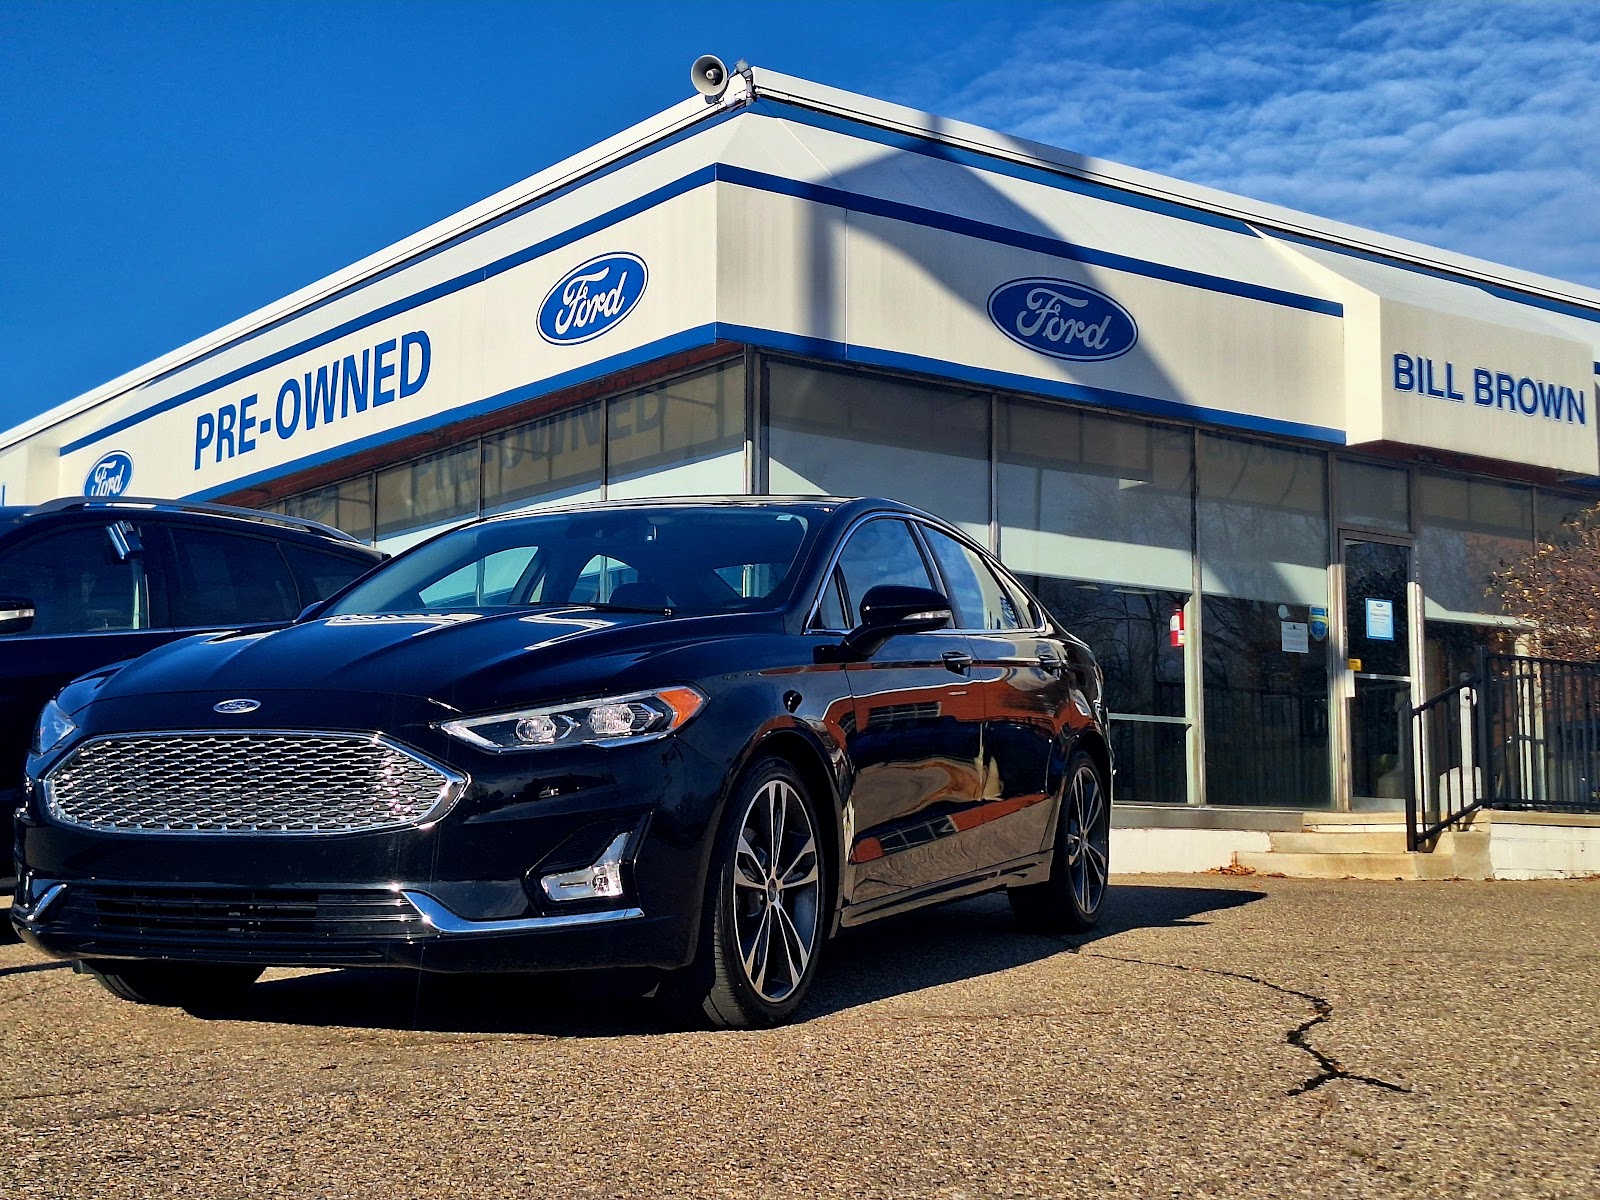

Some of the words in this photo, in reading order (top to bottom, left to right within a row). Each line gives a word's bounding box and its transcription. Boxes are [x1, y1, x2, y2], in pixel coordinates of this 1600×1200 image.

[555, 266, 627, 335] Ford
[1016, 287, 1112, 350] Ford
[194, 329, 432, 471] PRE-OWNED
[1393, 352, 1465, 403] BILL
[1474, 367, 1586, 425] BROWN
[91, 459, 125, 497] Ford
